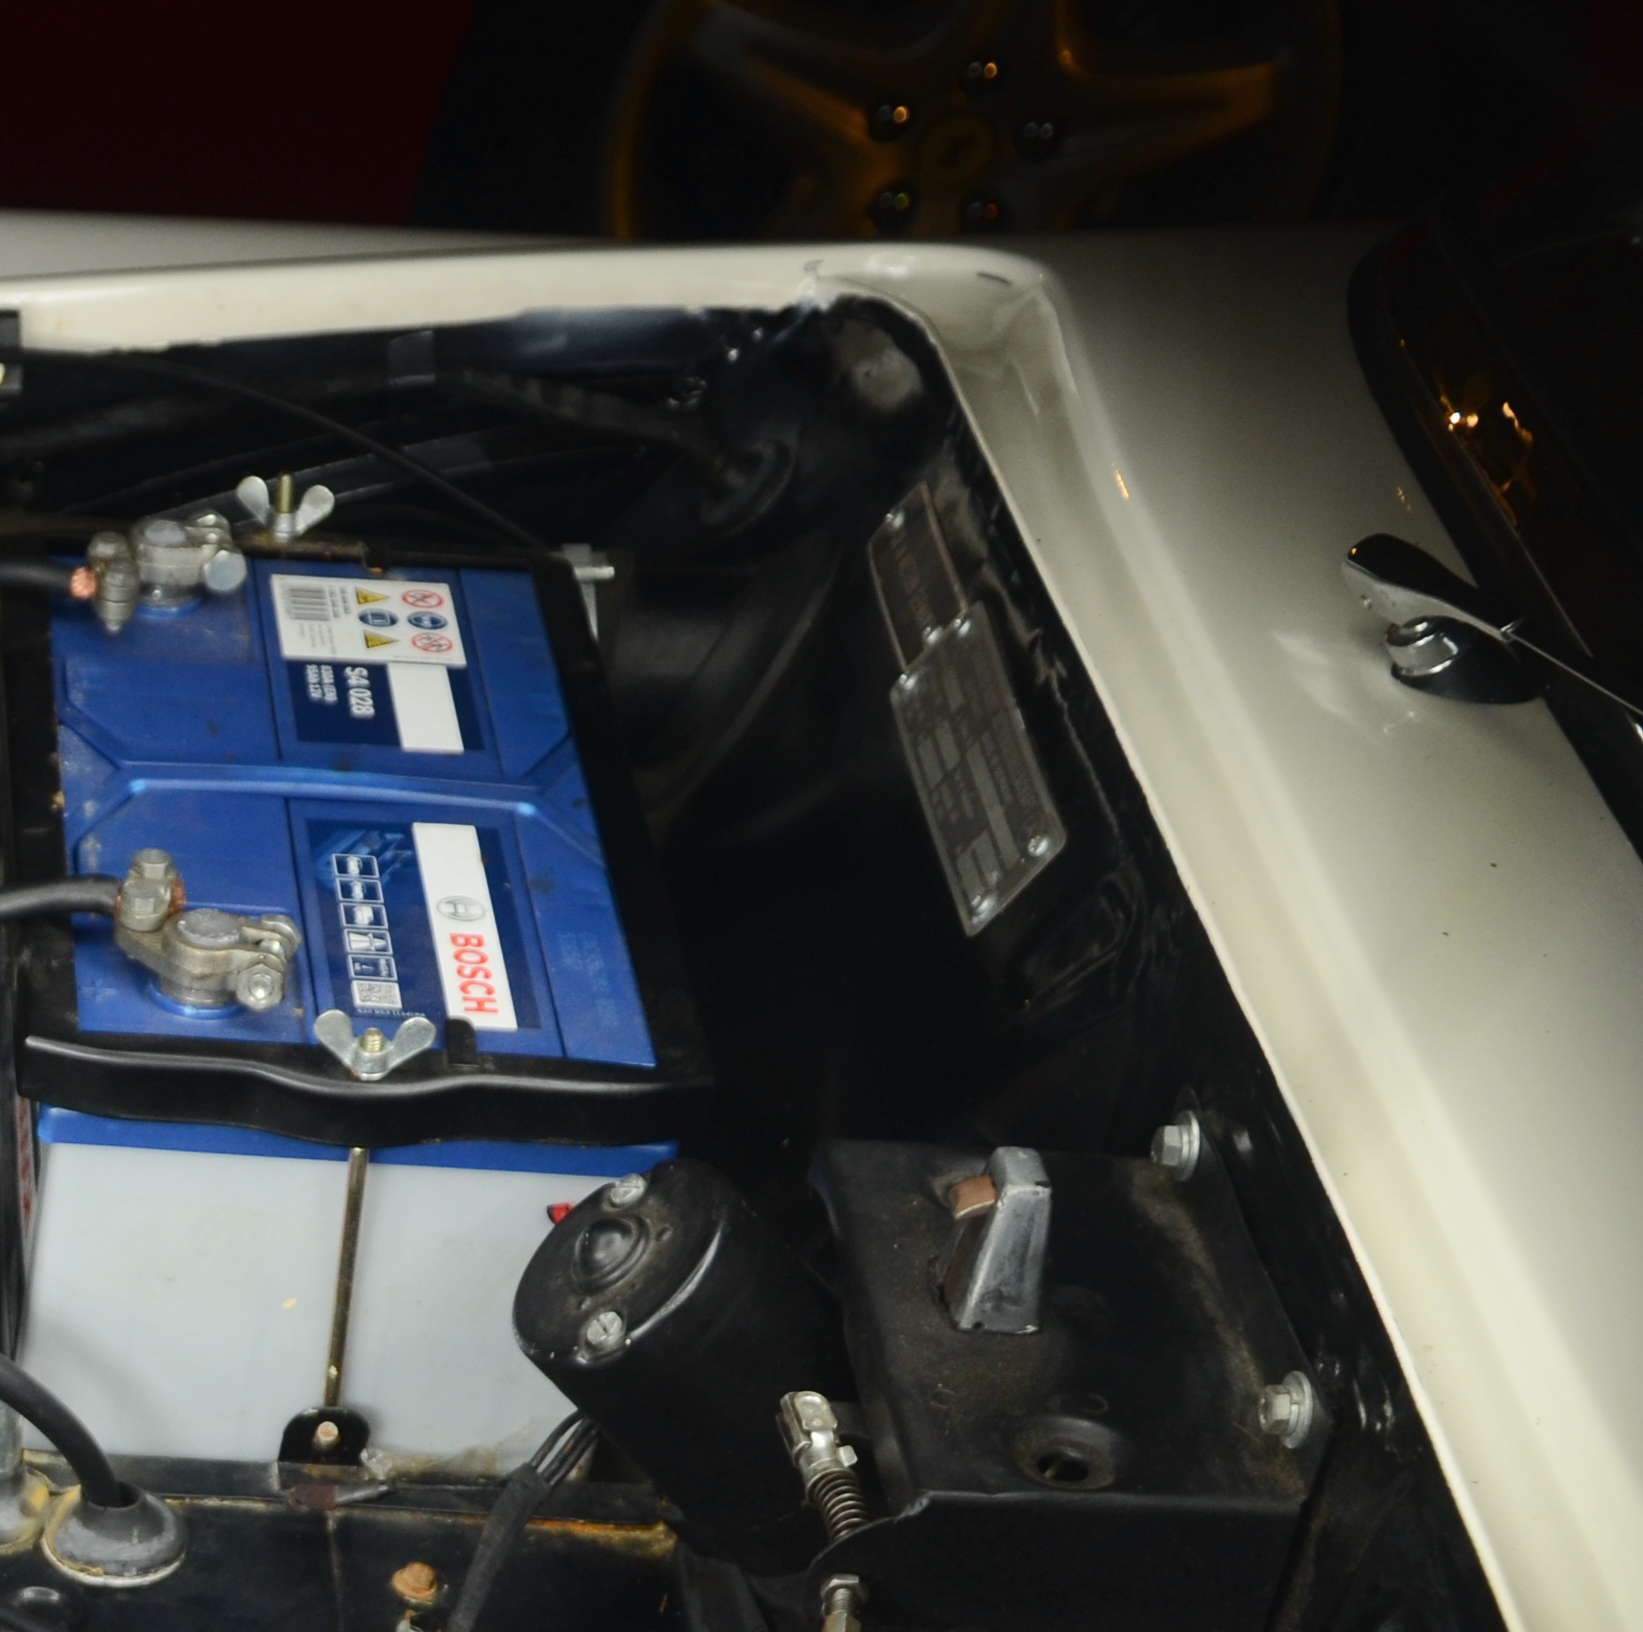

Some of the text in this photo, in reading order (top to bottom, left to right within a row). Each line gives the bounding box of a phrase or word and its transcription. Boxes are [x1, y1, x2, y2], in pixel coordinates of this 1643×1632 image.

[344, 665, 375, 718] S4 028
[449, 932, 499, 1014] BOSCH
